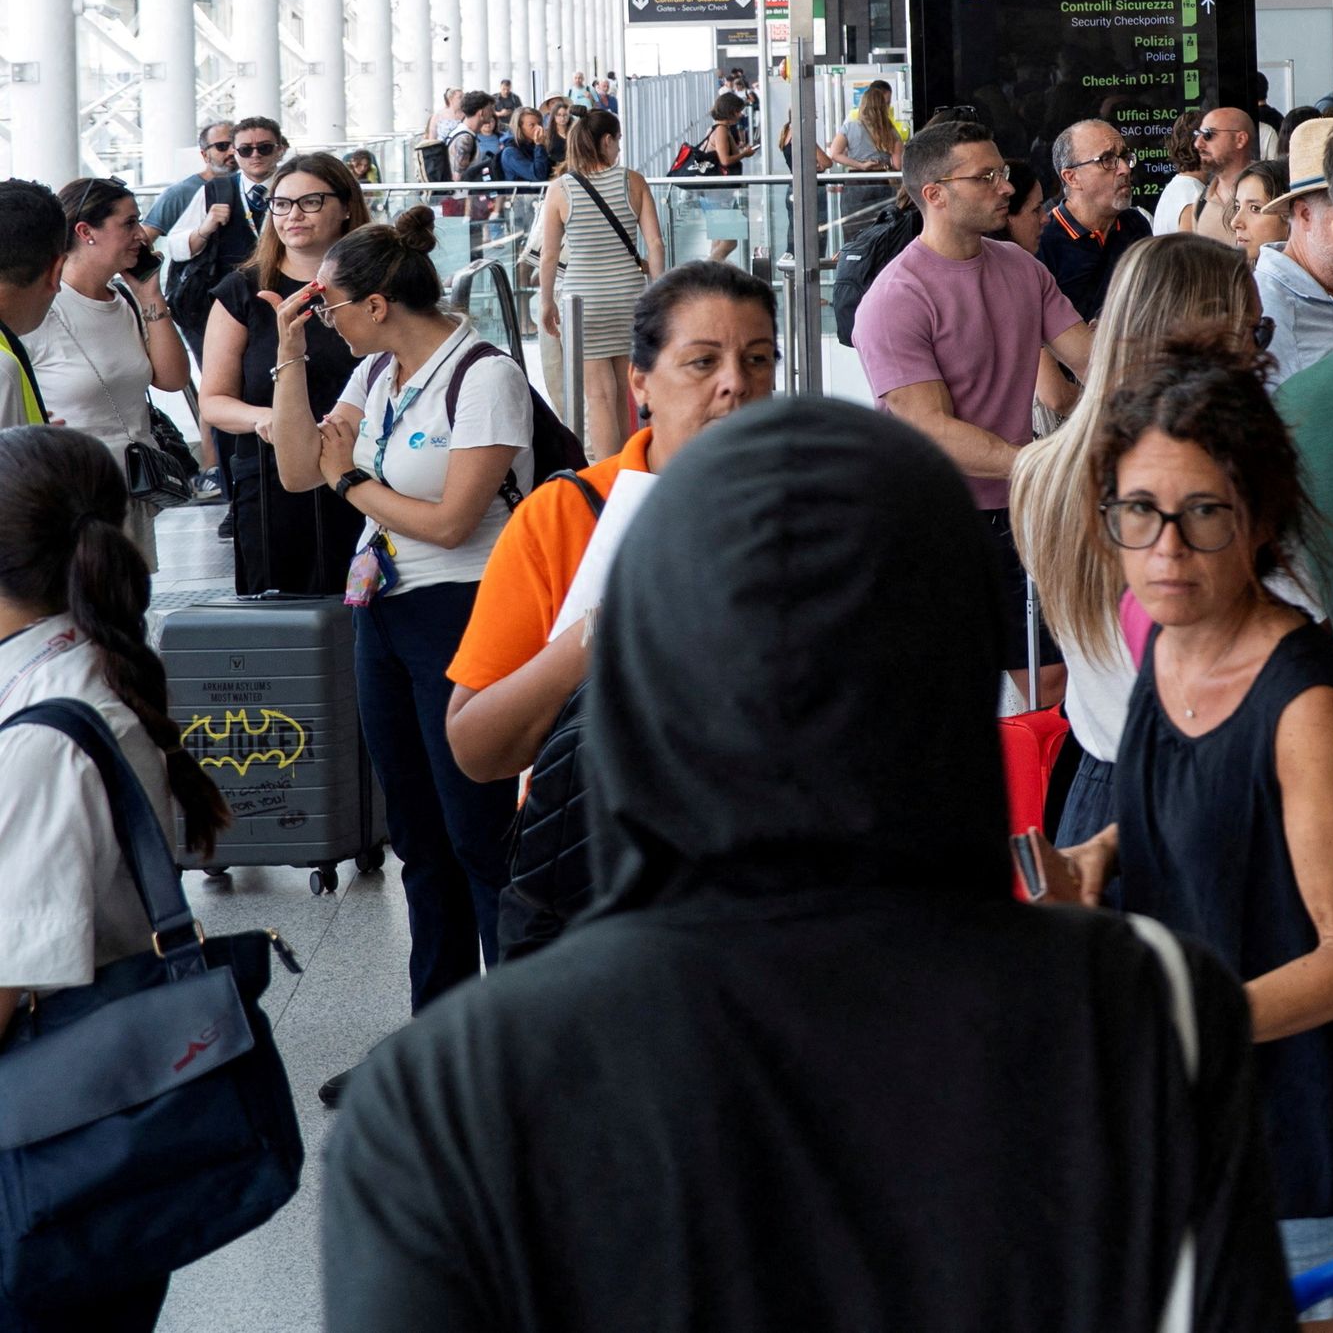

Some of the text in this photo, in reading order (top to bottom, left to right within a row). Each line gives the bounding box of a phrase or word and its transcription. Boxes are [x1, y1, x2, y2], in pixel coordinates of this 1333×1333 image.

[656, 3, 728, 12] Gates Security Check
[1060, 0, 1112, 12] Controlli
[1071, 15, 1175, 28] Security Checkpoints
[1134, 36, 1175, 48] Polizia
[1146, 51, 1176, 62] Police
[1082, 73, 1175, 87] Check-in 01-21
[1117, 109, 1178, 121] Uffici SAC
[1121, 126, 1142, 136] SAC
[203, 682, 235, 692] ARKHAM
[211, 692, 263, 702] MOST WANTED
[228, 725, 315, 759] JOKER
